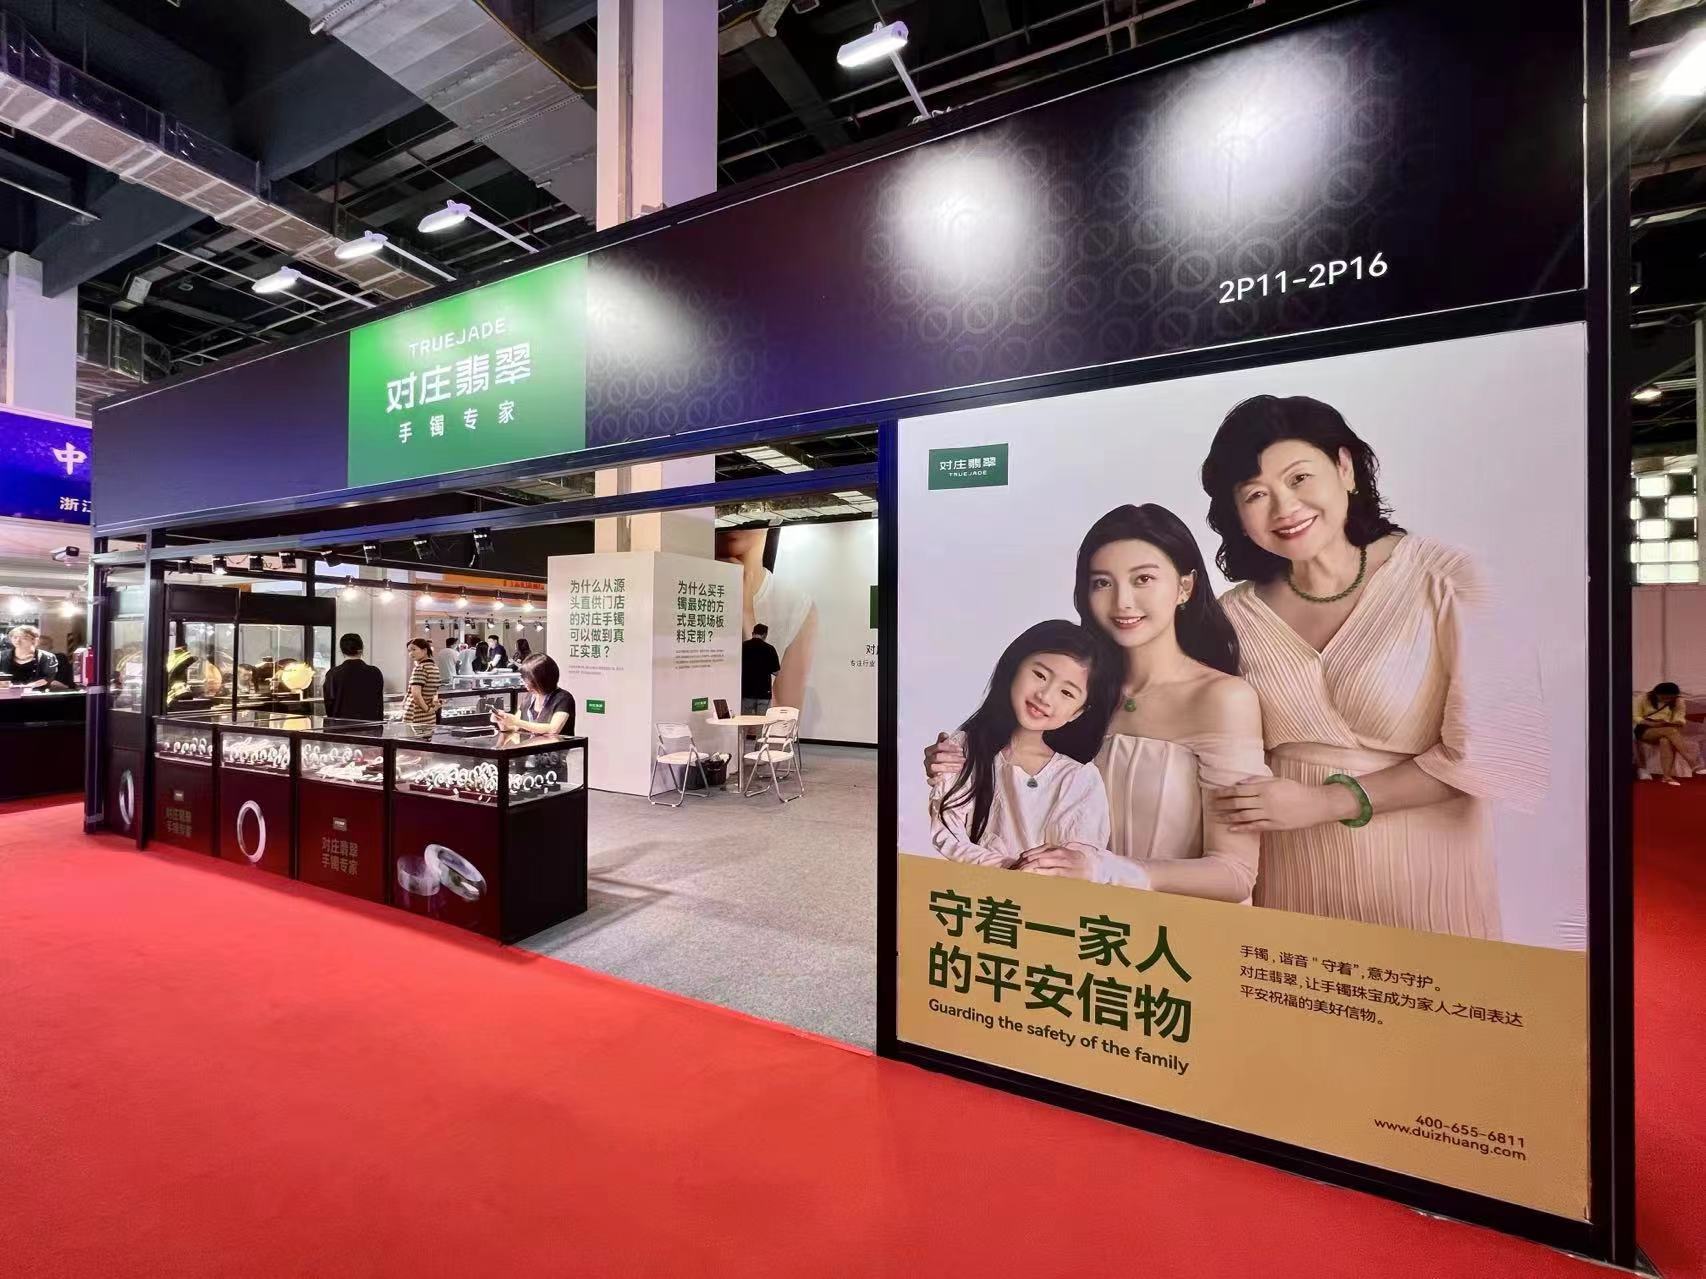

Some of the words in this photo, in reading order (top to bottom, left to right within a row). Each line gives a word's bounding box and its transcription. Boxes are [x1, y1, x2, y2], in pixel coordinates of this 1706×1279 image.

[1218, 252, 1388, 304] 2P11-2P16
[408, 318, 507, 359] TRUEJADE
[385, 342, 532, 414] 对庄翡翠
[398, 400, 515, 444] 手镯专家
[52, 442, 87, 476] 中
[939, 456, 997, 471] 对庄翡翠
[569, 578, 626, 594] 为什么从源
[569, 594, 626, 610] 头直供门店
[677, 580, 725, 598] 为什么买手
[569, 611, 625, 627] 的对庄手镯
[676, 612, 725, 628] 式是现场板
[677, 596, 725, 613] 镯最好的方
[569, 627, 625, 643] 可以做到真
[865, 643, 878, 655] 对
[928, 889, 1193, 983] 守着一家人
[928, 942, 1192, 1044] 的平安信物
[1239, 985, 1385, 1025] 平安祝福的美好信物。
[928, 998, 995, 1029] Guarding
[997, 1015, 1023, 1033] the
[1026, 1023, 1076, 1046] safety
[1080, 1036, 1099, 1049] of
[1101, 1040, 1131, 1058] the
[1135, 1047, 1190, 1075] family
[1374, 1118, 1527, 1161] www.duizhuang.com
[1415, 1115, 1525, 1149] 400-655-6811
